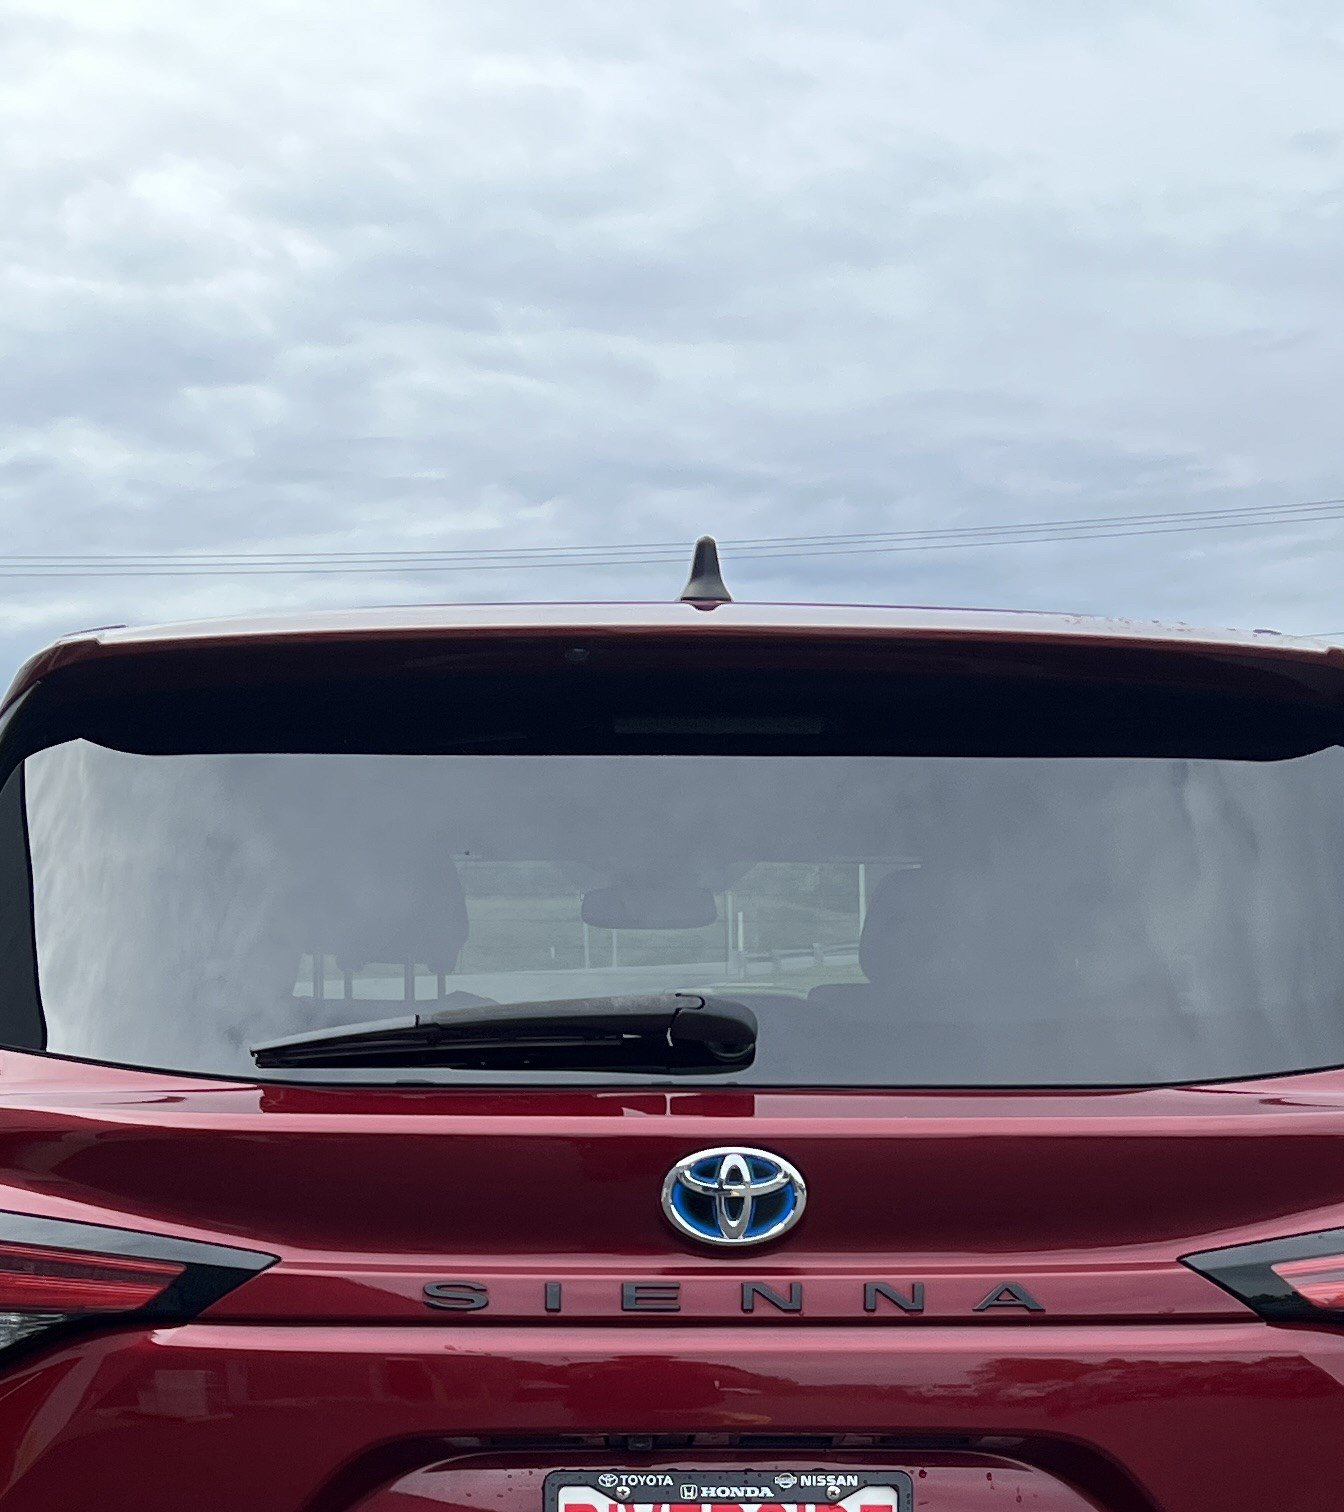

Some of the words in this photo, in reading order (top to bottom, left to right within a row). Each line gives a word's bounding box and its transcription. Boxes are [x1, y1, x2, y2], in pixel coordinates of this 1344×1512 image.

[421, 1280, 1046, 1312] SIENNA
[620, 1474, 673, 1487] TOYOTA
[800, 1475, 858, 1487] NISSAN
[701, 1487, 774, 1498] HONDA
